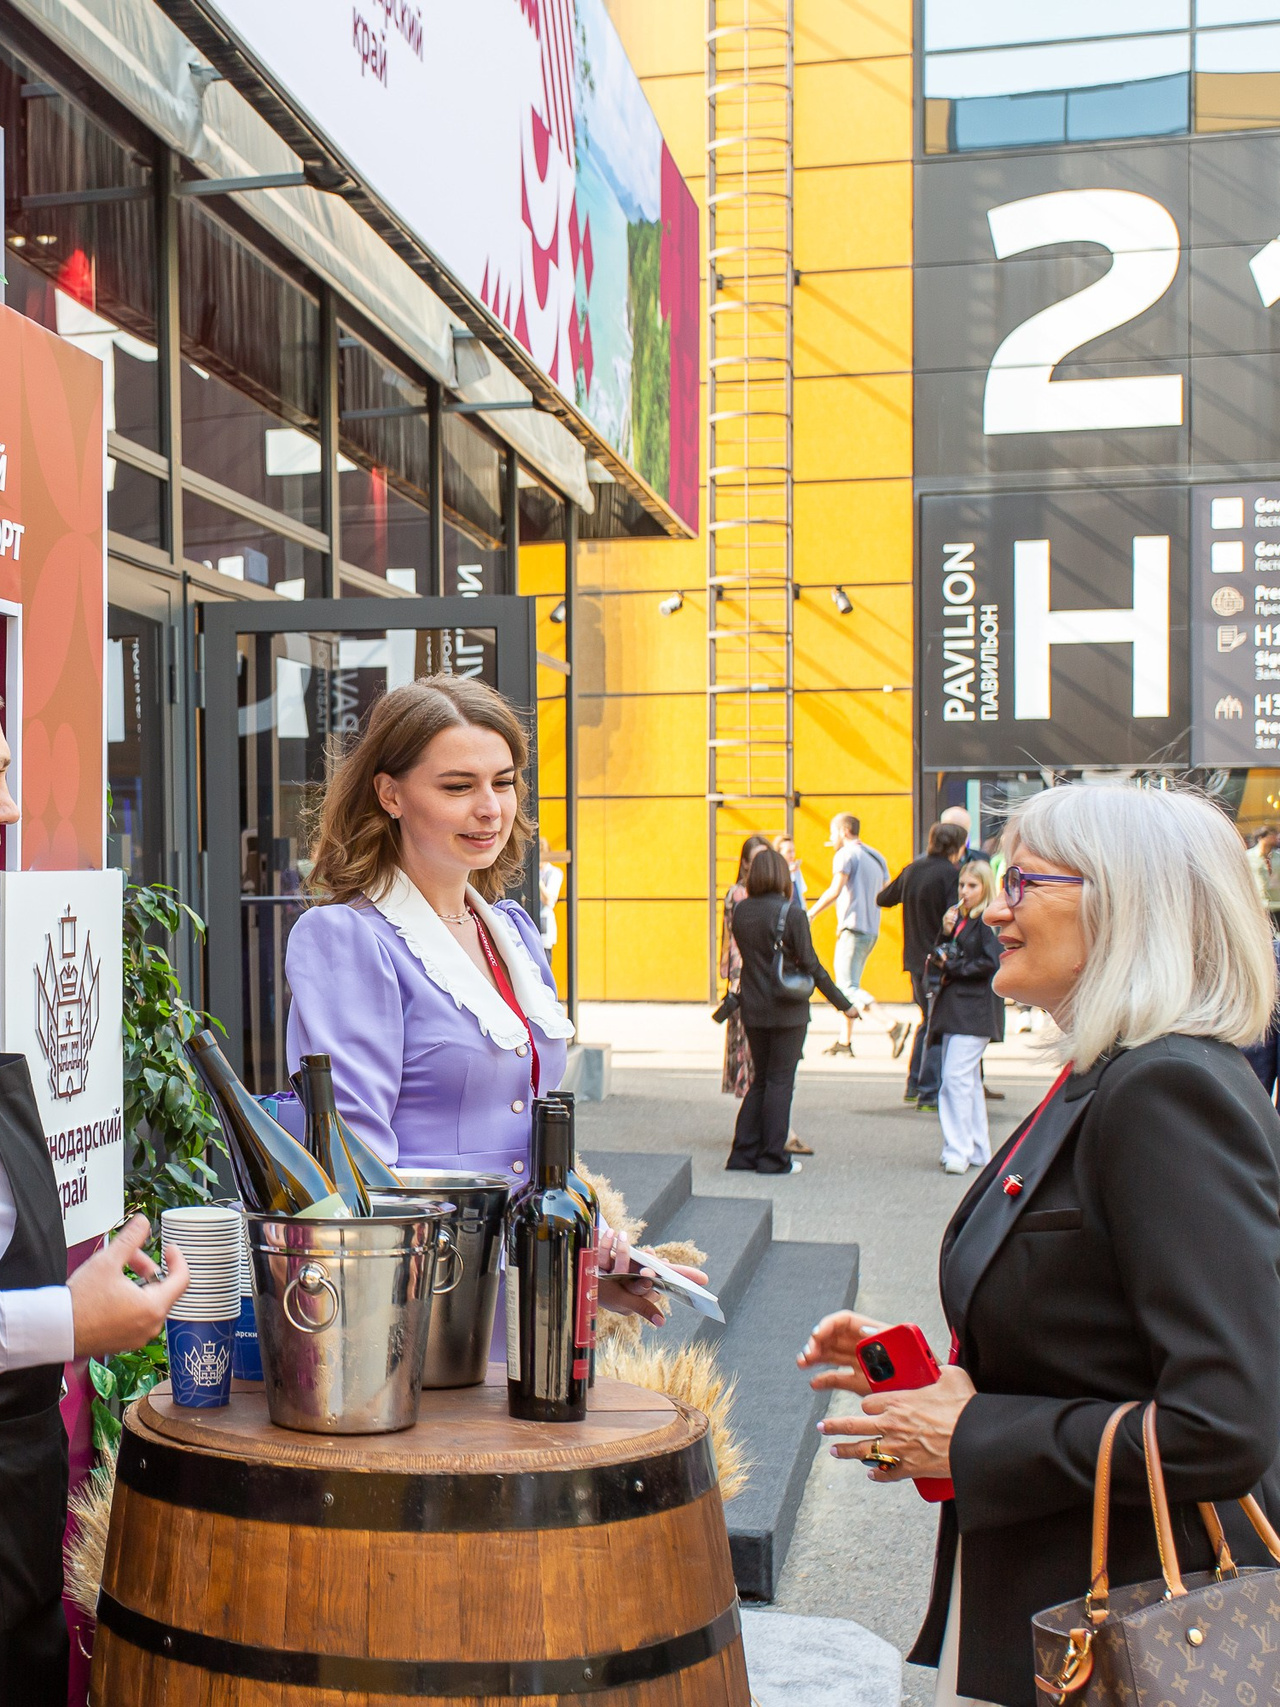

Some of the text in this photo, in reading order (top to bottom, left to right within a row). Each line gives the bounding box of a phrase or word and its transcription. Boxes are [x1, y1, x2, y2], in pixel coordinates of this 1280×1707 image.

[352, 6, 388, 88] край
[943, 542, 975, 722] PAVILION
[980, 604, 999, 721] ПАВИЛЬОН
[1014, 535, 1169, 720] H
[45, 1106, 122, 1164] нодарский
